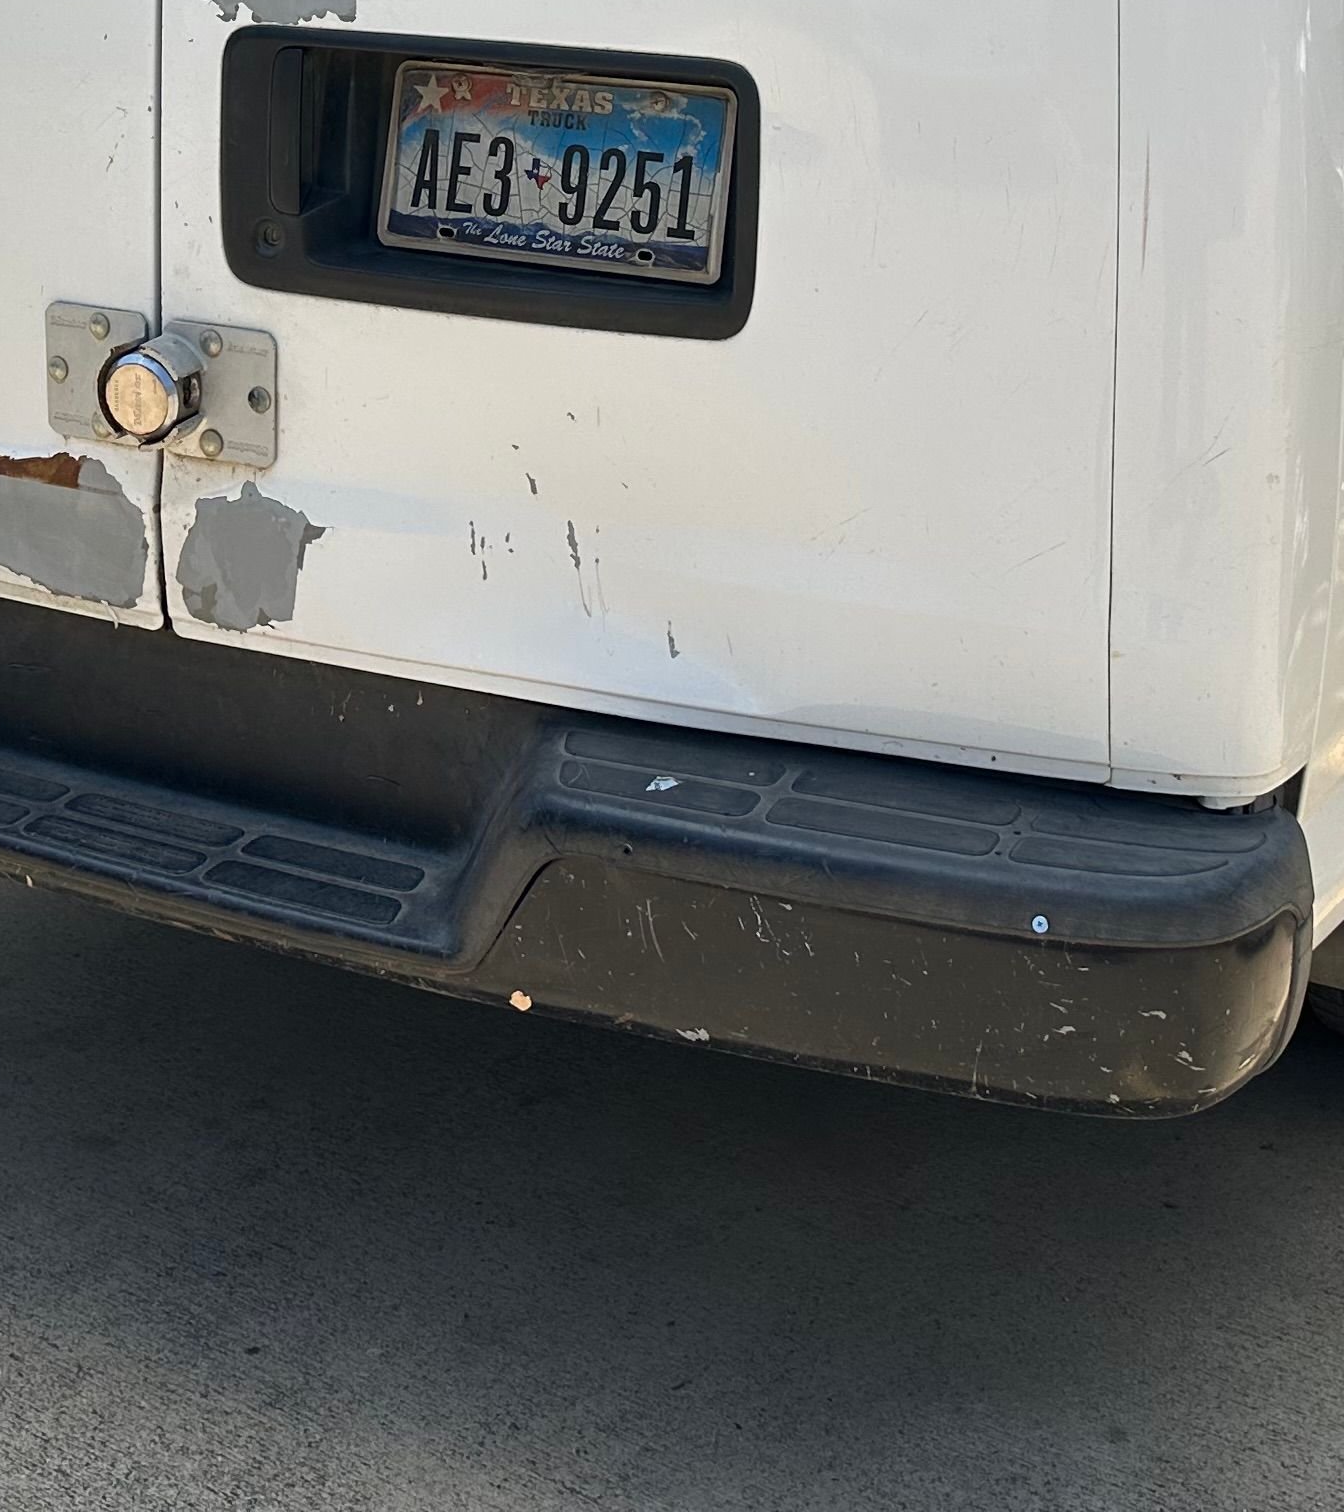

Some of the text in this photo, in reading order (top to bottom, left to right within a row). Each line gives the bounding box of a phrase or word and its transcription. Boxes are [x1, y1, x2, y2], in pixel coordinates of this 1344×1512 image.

[506, 83, 614, 116] TEXAS
[528, 110, 587, 131] TRUCK
[411, 128, 696, 241] AE3 9251
[462, 221, 626, 260] The Lone Star State
